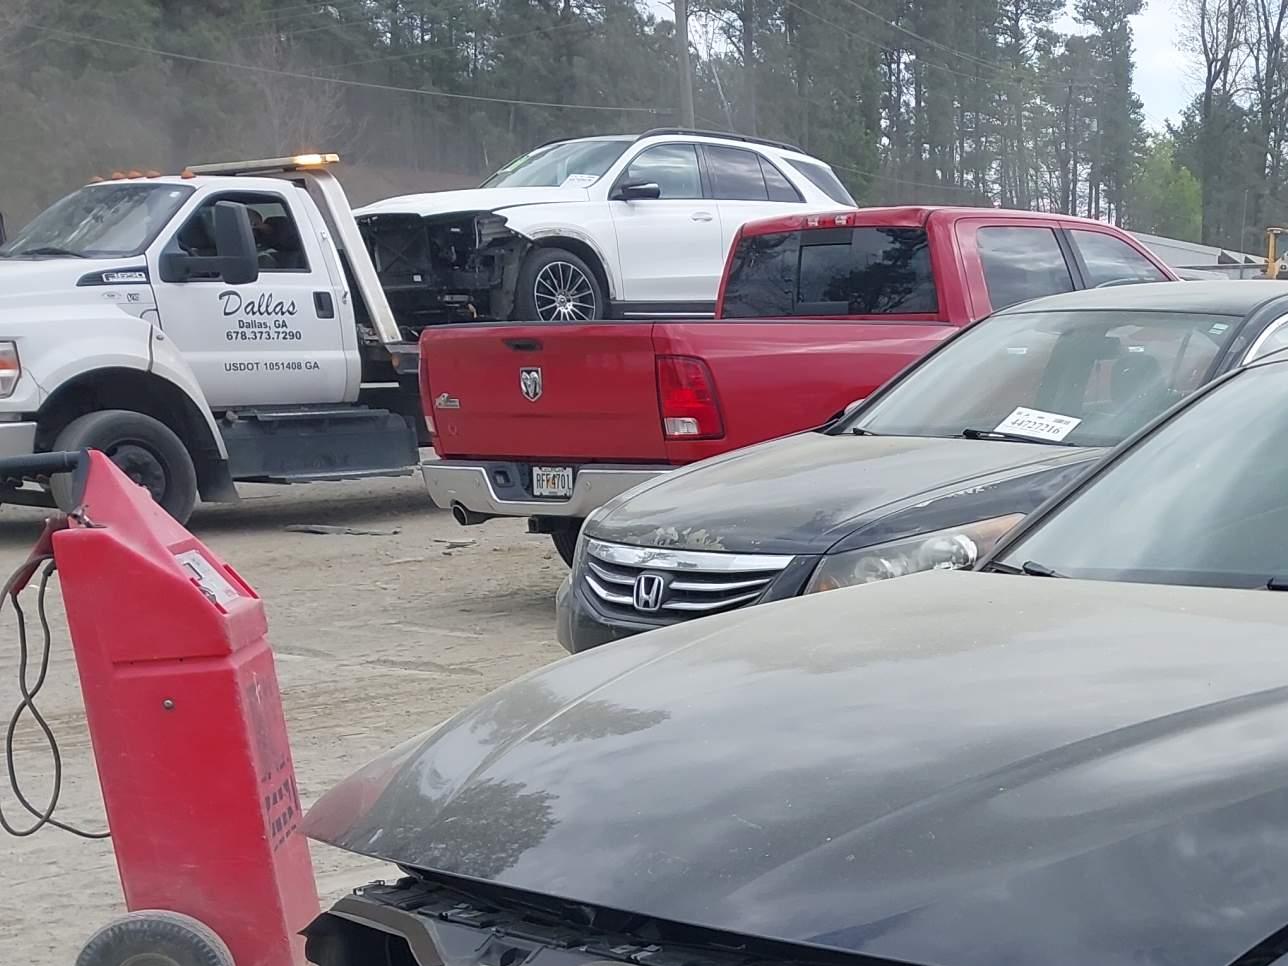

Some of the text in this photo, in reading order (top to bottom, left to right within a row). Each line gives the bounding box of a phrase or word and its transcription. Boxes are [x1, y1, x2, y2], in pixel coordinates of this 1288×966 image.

[218, 290, 298, 316] Dallas
[238, 319, 289, 331] Dallas, GA
[226, 330, 302, 341] 678.373.7290
[224, 361, 320, 371] USDOT 1051408 GA
